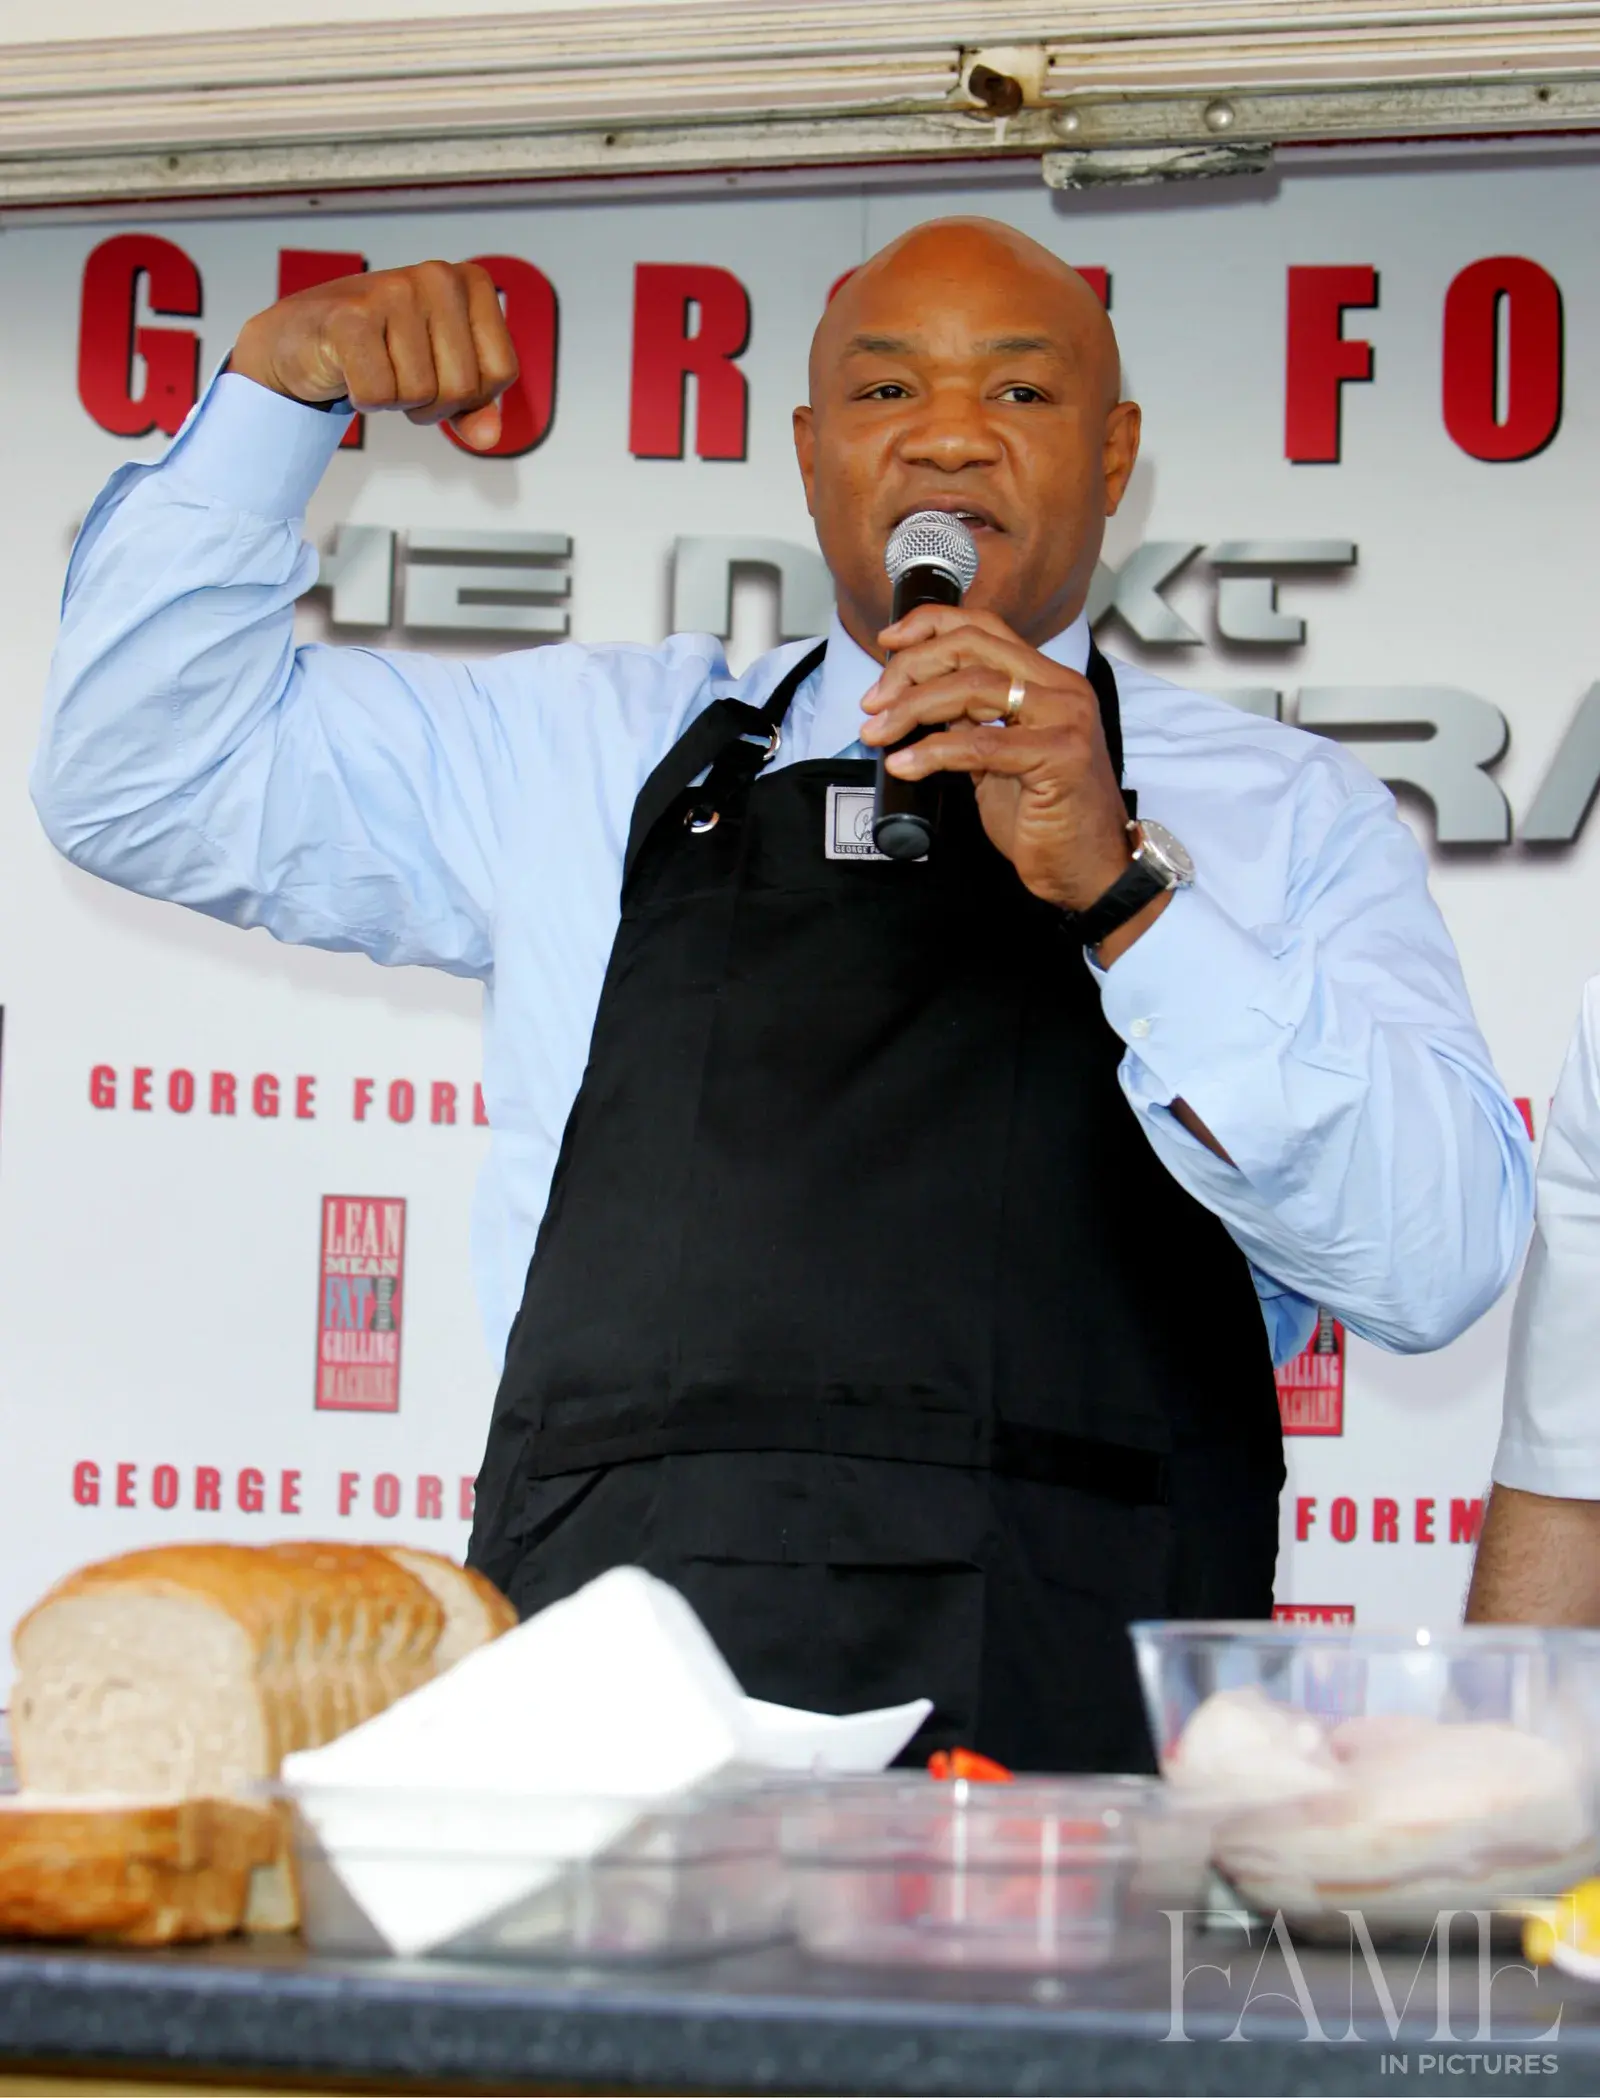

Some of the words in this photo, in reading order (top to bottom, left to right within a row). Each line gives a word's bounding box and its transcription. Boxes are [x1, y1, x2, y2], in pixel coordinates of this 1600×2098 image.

[835, 845, 868, 853] GEORGE
[89, 1063, 317, 1119] GEORGE
[326, 1201, 401, 1256] LEAN
[325, 1256, 398, 1275] MEAN
[324, 1276, 371, 1329] FAT
[322, 1330, 397, 1364] GRILLING
[72, 1459, 302, 1515] GEORGE
[337, 1471, 476, 1521] FORE
[1295, 1496, 1485, 1544] FOREM
